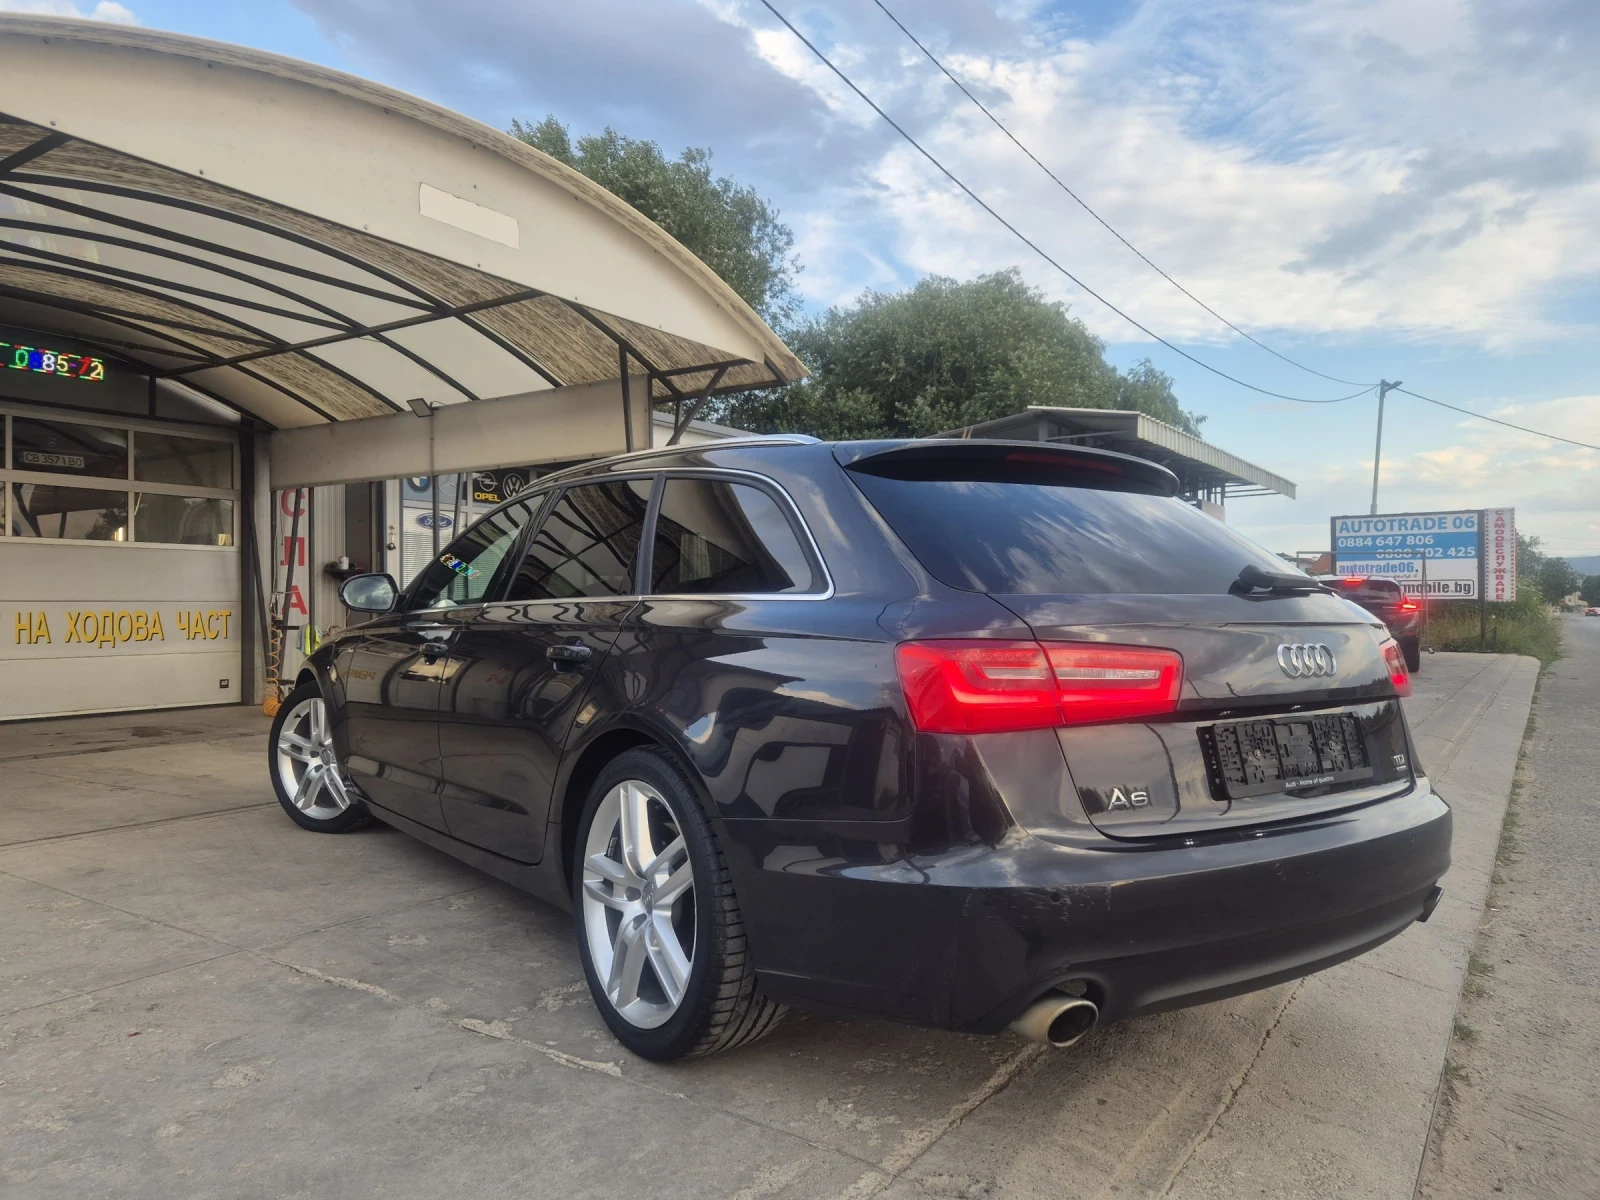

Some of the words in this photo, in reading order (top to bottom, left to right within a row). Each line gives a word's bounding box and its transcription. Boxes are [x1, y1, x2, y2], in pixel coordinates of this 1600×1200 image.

[42, 455, 67, 465] 3571
[474, 492, 501, 502] OPEL
[1339, 516, 1448, 534] AUTOTRADE
[1452, 515, 1476, 530] 06
[1338, 537, 1373, 548] 0884
[1375, 536, 1403, 547] 647
[1406, 535, 1434, 546] 806
[1415, 547, 1443, 558] 702
[1447, 546, 1476, 557] 425
[1403, 581, 1472, 595] mobile.bg
[14, 611, 51, 645] НА
[64, 610, 165, 649] ХОДОВА
[176, 609, 232, 641] ЧАСТ
[1319, 776, 1335, 784] quattro
[1108, 787, 1149, 810] A6
